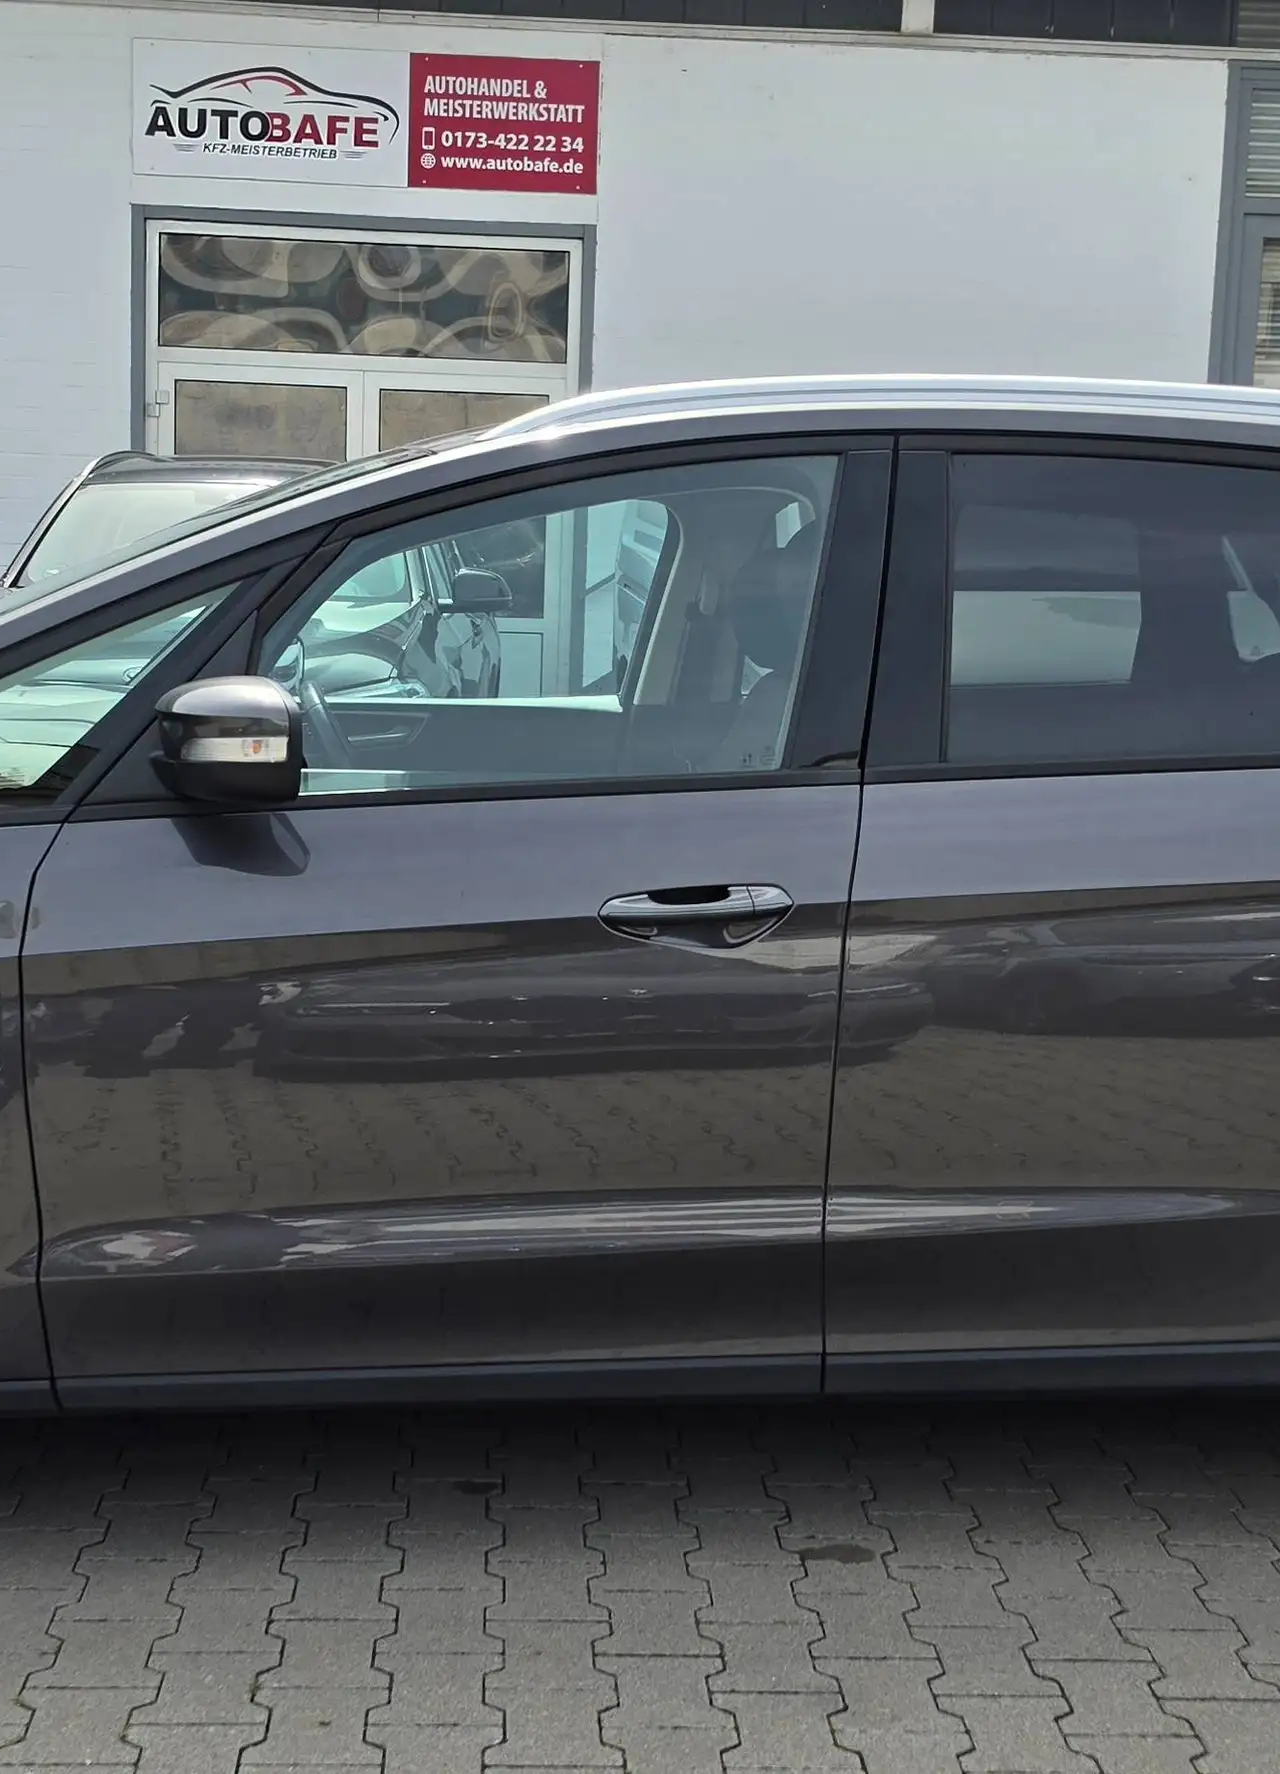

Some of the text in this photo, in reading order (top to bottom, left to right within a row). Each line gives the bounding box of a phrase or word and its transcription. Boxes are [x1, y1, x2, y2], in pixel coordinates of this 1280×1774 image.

[423, 75, 547, 98] AUTOHANDEL &
[423, 98, 585, 123] MEISTERWERKSTATT
[144, 105, 380, 148] AUTOBAFE
[202, 142, 338, 160] KFZ-MEISTERBETRIEB
[441, 131, 585, 153] 0173-422 22 34
[440, 156, 584, 174] www.autobafe.de
